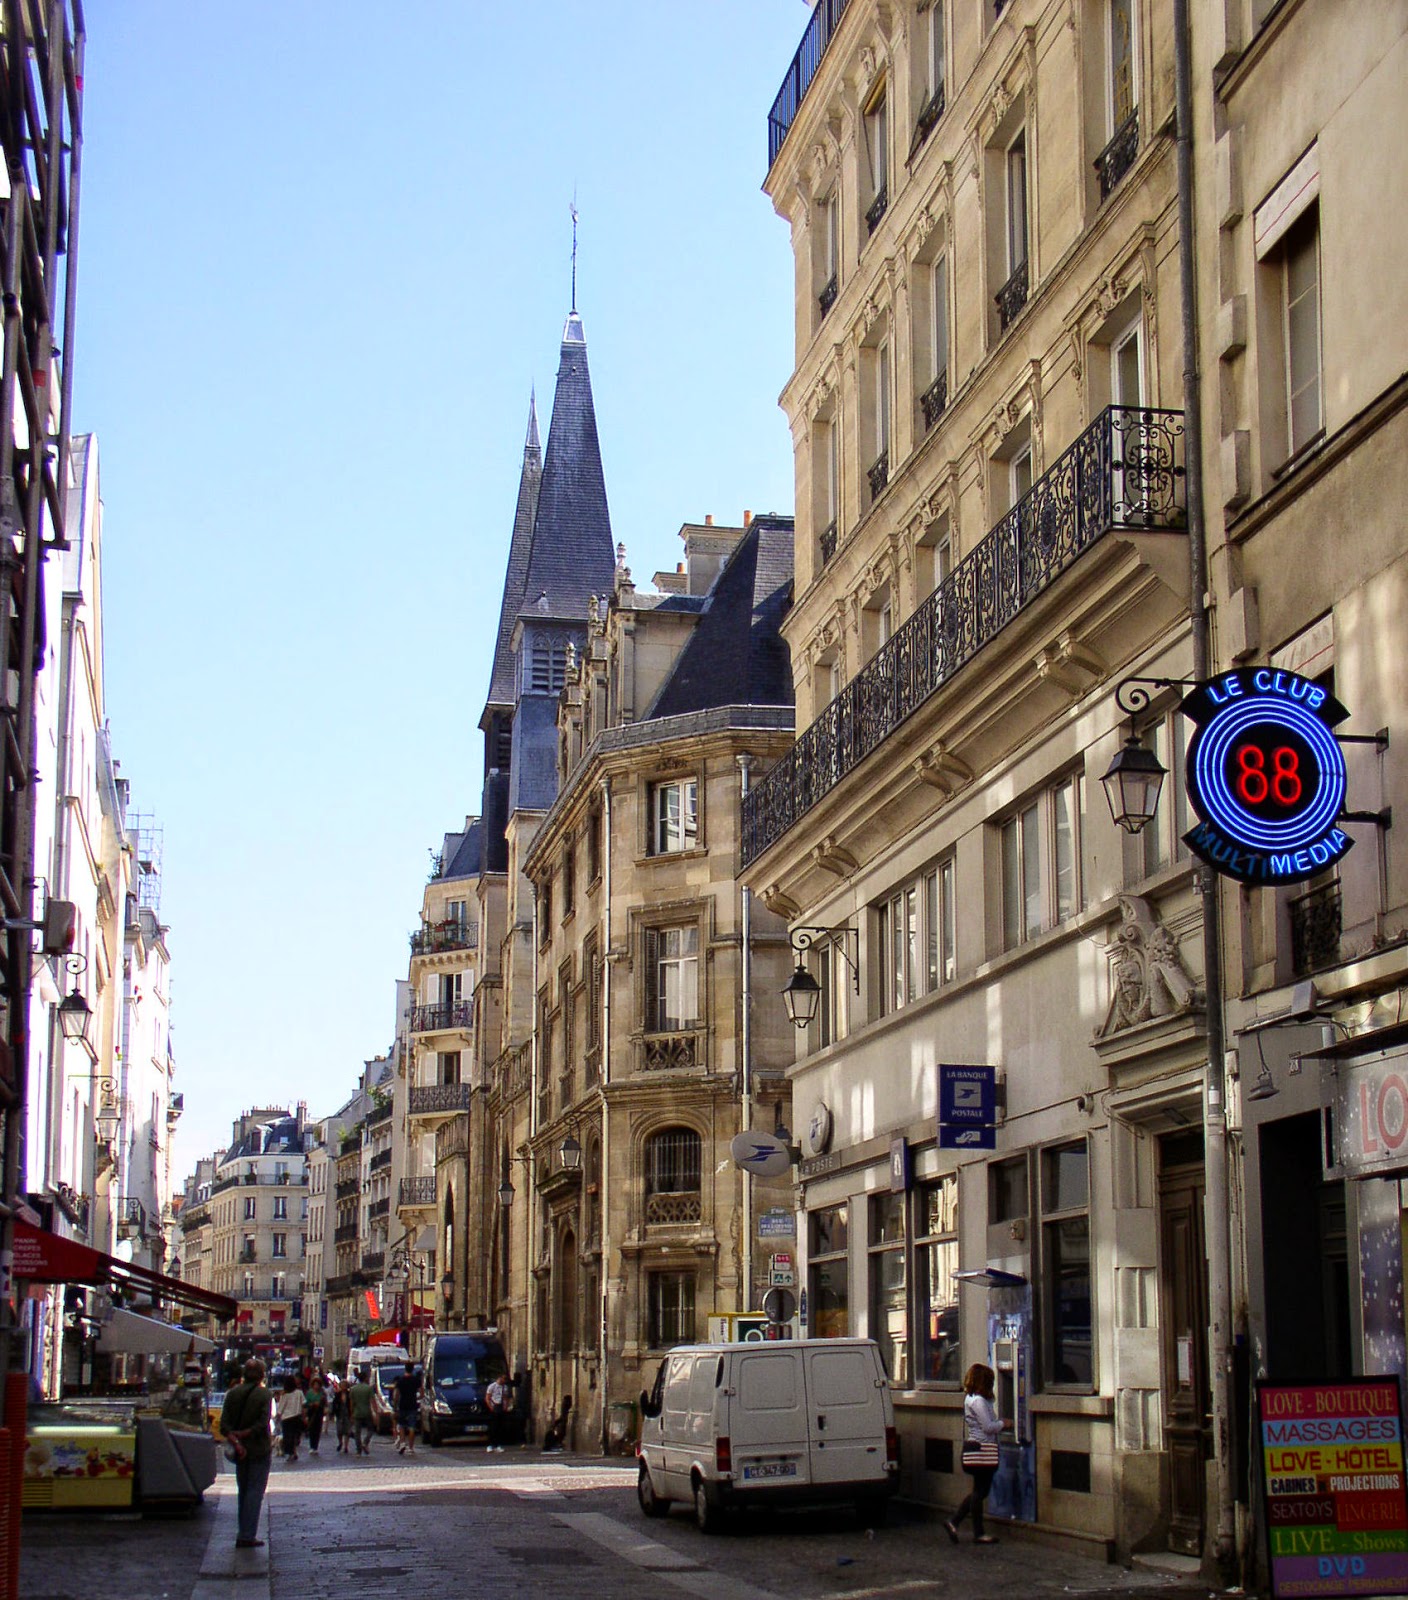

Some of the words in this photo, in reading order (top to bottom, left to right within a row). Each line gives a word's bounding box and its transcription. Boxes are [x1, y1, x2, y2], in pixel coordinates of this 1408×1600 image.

[1206, 675, 1244, 705] LE
[1254, 669, 1327, 709] CLUB
[1237, 744, 1302, 806] 88
[957, 1071, 988, 1080] BANQUE
[951, 1109, 984, 1118] POSTALE
[811, 1156, 834, 1172] POSTE
[1265, 1392, 1304, 1415] LOVE
[1315, 1388, 1395, 1417] BOUTIQUE
[1267, 1420, 1396, 1443] MASSAGES
[1270, 1451, 1322, 1472] LOVE
[1271, 1477, 1316, 1494] CABINES
[1329, 1474, 1400, 1492] PROJECTIONS
[1272, 1500, 1333, 1519] SEXTOYS
[1336, 1502, 1401, 1522] LINGERIE
[1275, 1529, 1336, 1553] LIVE
[1353, 1532, 1406, 1552] Shows
[1318, 1556, 1366, 1578] DVD
